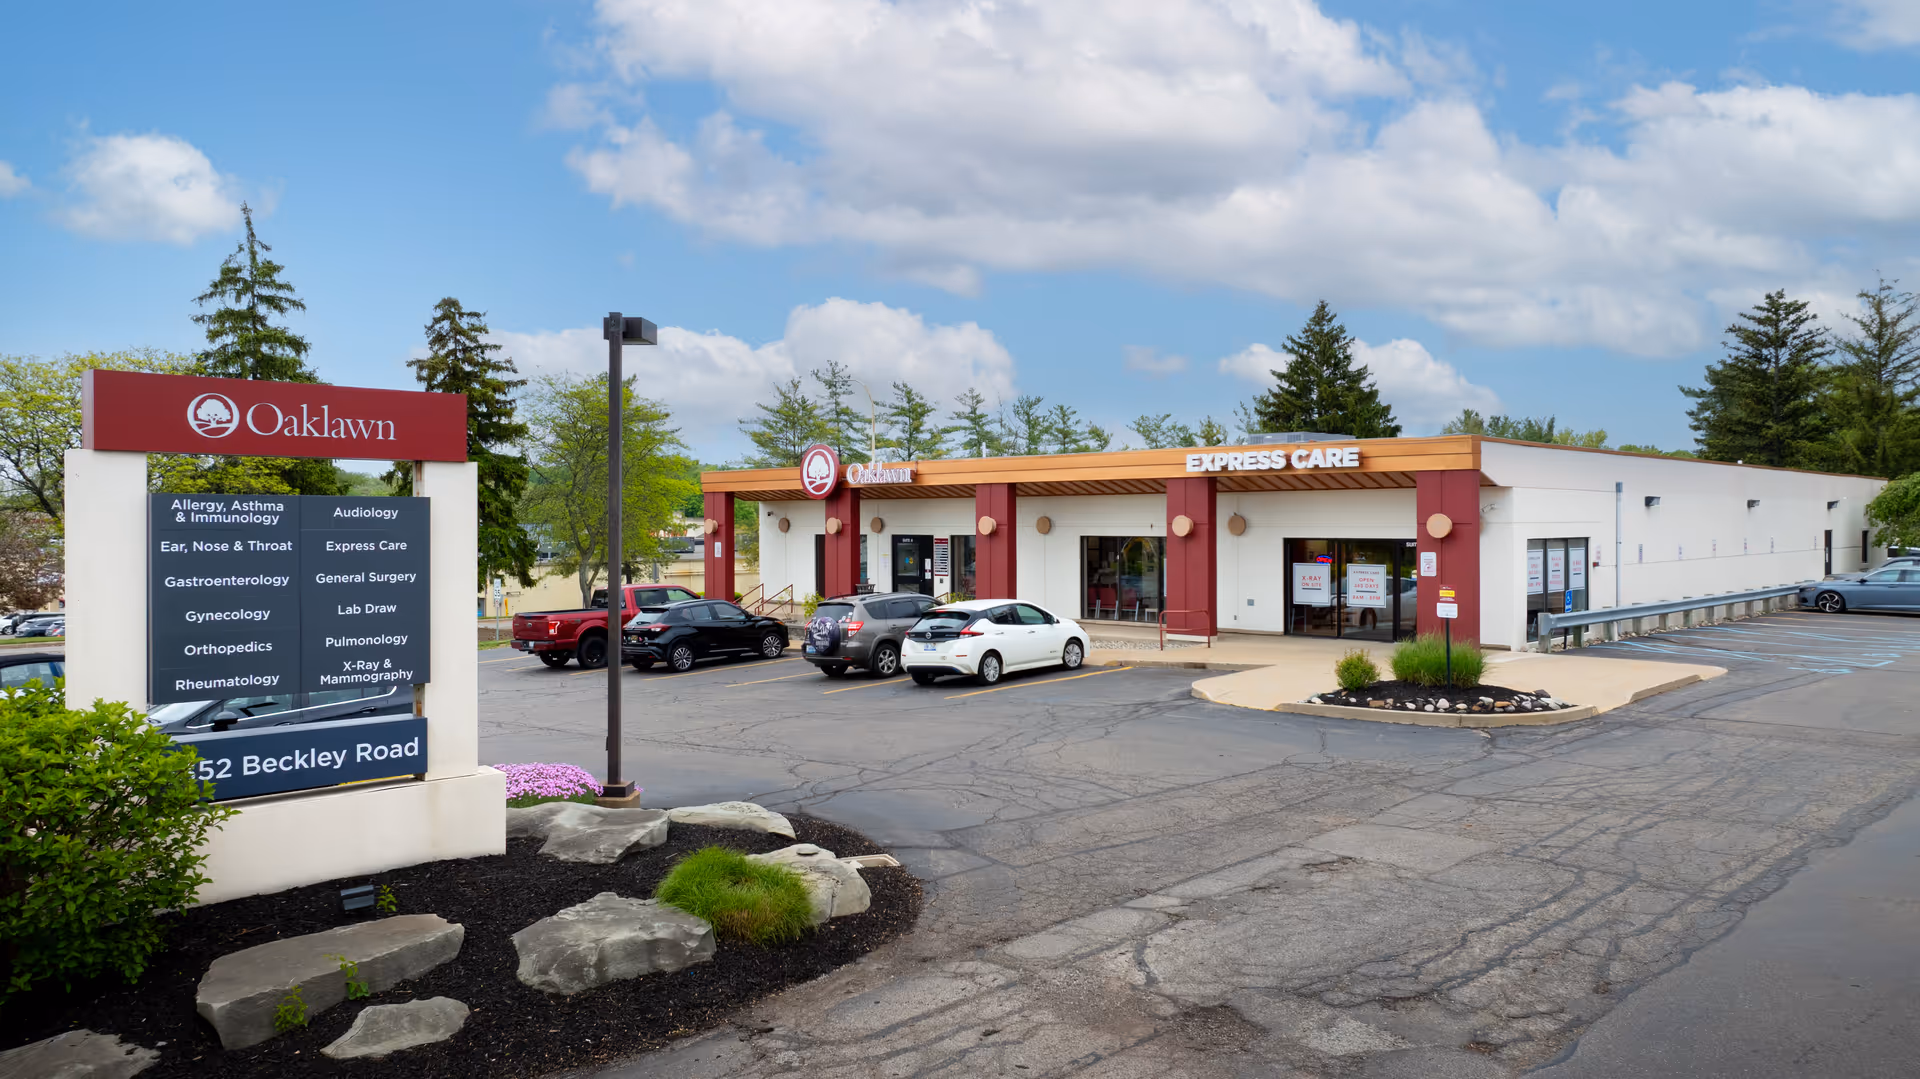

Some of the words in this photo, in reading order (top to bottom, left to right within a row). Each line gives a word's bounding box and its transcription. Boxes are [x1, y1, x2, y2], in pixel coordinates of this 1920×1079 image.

[246, 402, 397, 441] Oaklawn
[1186, 449, 1287, 472] EXPRESS
[1290, 447, 1361, 470] CARE
[846, 461, 913, 485] Oaklawn
[171, 499, 227, 513] Allergy,
[231, 500, 284, 512] Asthma
[333, 507, 399, 519] Audiology
[175, 512, 186, 523] &
[191, 512, 280, 525] Immunology
[160, 541, 188, 553] Ear,
[193, 541, 229, 552] Nose
[233, 541, 243, 552] &
[248, 540, 293, 551] Throat
[326, 541, 376, 553] Express
[379, 540, 408, 551] Care
[164, 574, 290, 588] Gastroenterology
[315, 572, 365, 584] General
[368, 572, 417, 583] Surgery
[337, 604, 361, 615] Lab
[365, 603, 397, 614] Draw
[185, 609, 271, 624] Gynecology
[325, 634, 408, 648] Pulmonology
[184, 641, 273, 656] Orthopedics
[342, 660, 380, 672] X-Ray
[383, 658, 392, 669] &
[175, 674, 280, 691] Rheumatology
[320, 669, 413, 685] Mammography
[243, 748, 347, 776] Beckley
[356, 737, 419, 763] Road
